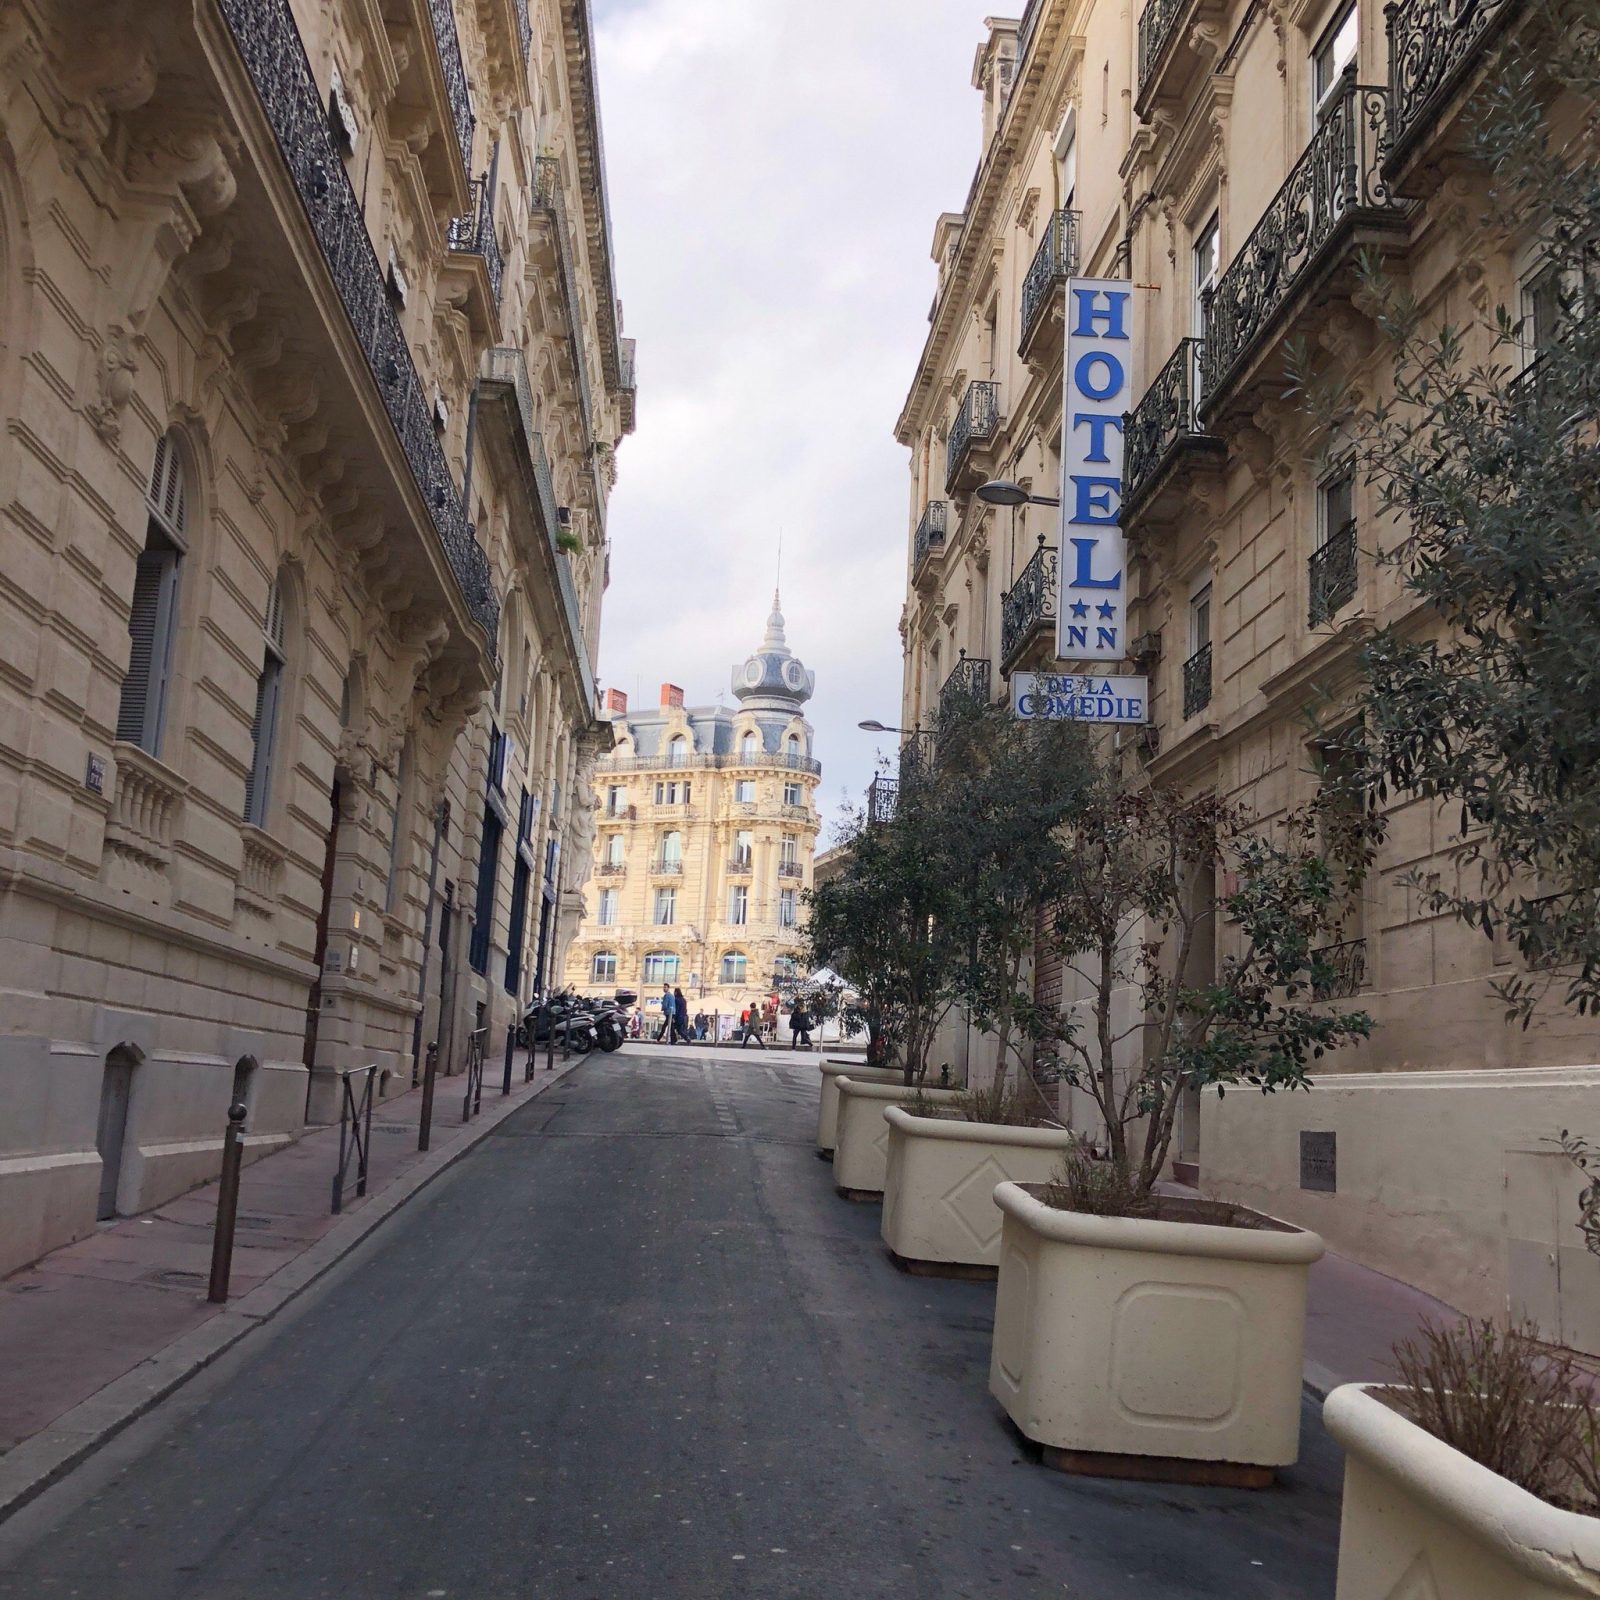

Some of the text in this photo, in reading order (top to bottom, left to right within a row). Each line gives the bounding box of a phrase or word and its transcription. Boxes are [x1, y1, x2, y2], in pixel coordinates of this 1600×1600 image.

[1070, 288, 1130, 589] HOTEL
[1046, 677, 1115, 696] DE LA
[1018, 694, 1143, 719] COMEDIE
